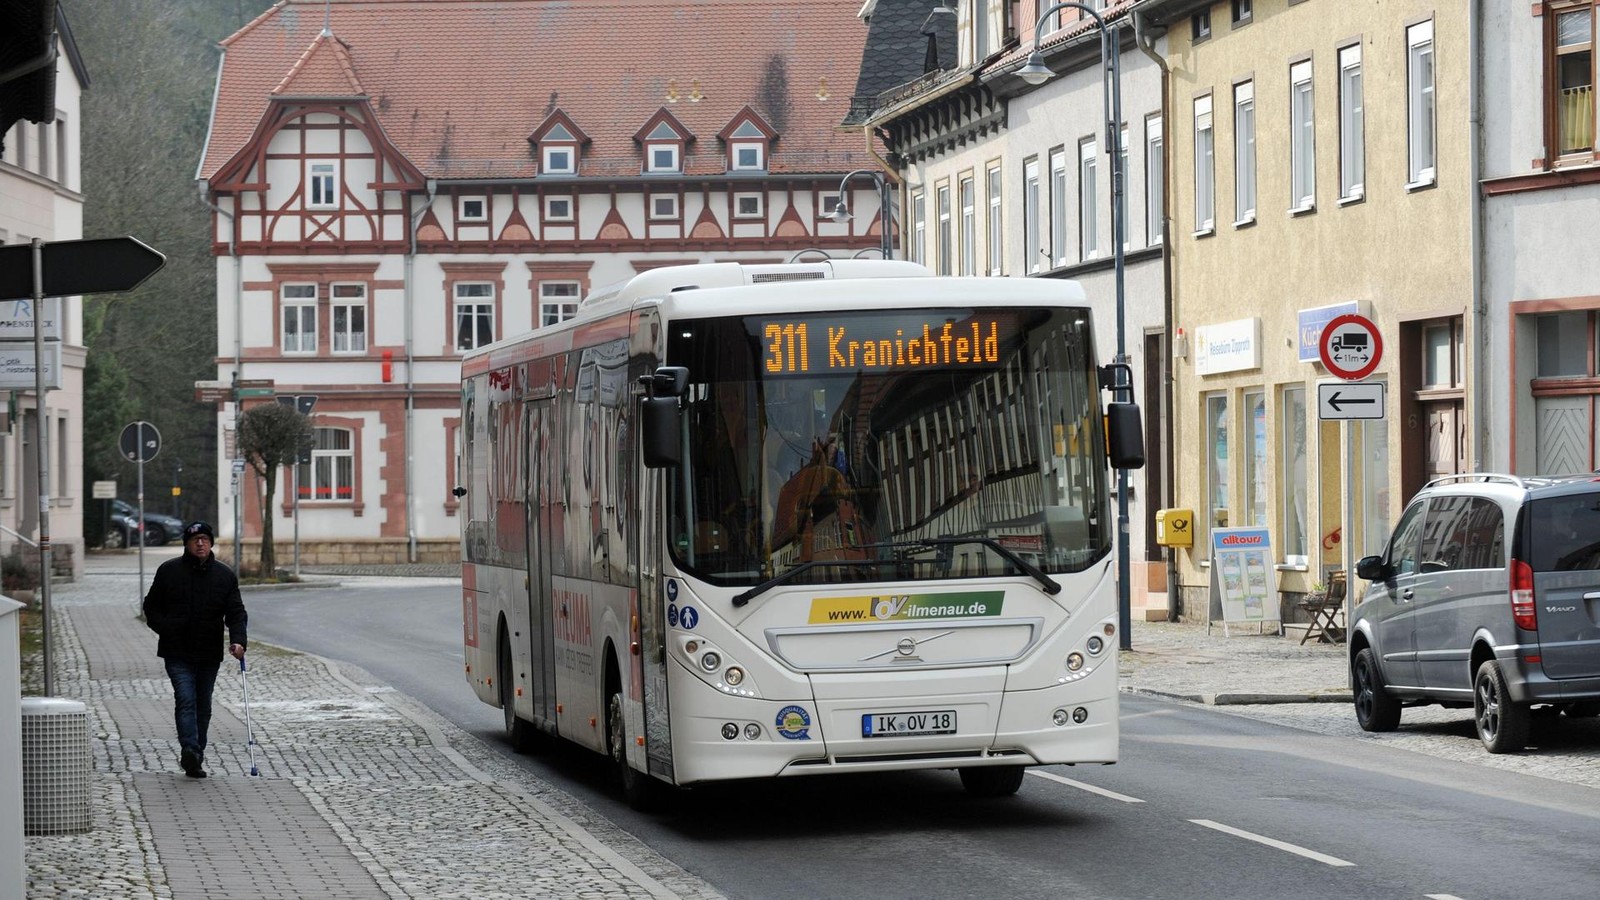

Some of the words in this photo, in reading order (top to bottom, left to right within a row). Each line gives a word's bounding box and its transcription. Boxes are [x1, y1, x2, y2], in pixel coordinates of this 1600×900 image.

[765, 323, 808, 372] 311
[828, 322, 998, 367] Kranichfeld
[1222, 535, 1262, 545] alltours
[552, 588, 592, 647] RHEUMA
[878, 716, 897, 732] IK
[907, 714, 927, 731] OV
[931, 713, 951, 729] 18
